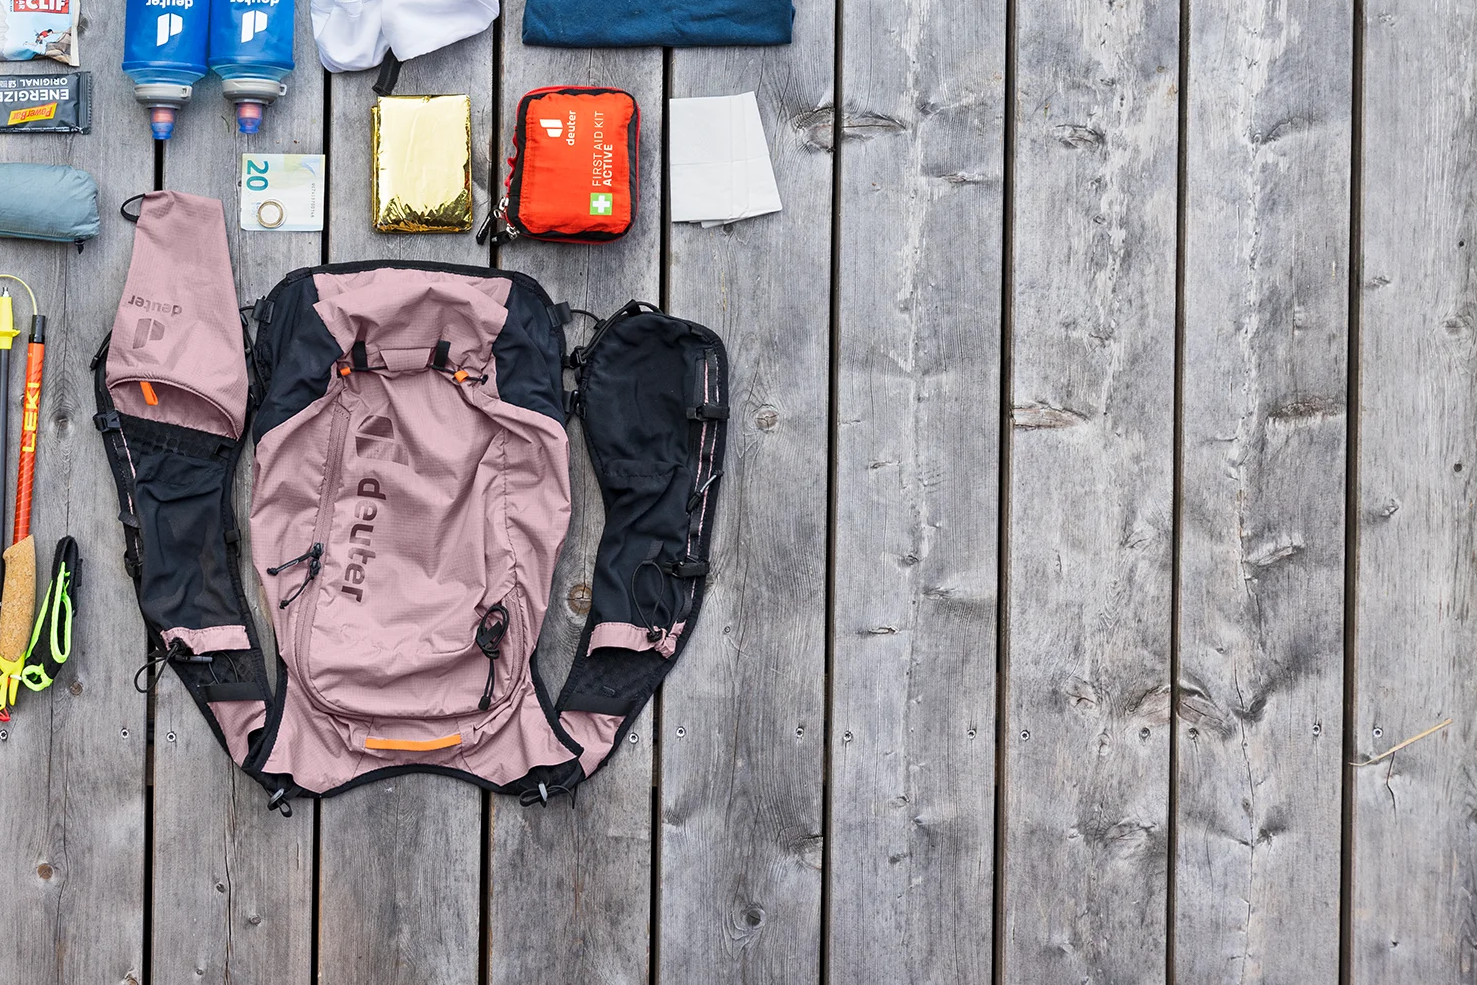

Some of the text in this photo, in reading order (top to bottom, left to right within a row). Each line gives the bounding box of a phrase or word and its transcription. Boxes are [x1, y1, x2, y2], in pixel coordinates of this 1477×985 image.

[20, 77, 68, 86] ORIGINAL
[11, 107, 52, 122] PowerBar
[565, 109, 576, 146] deuter
[592, 110, 604, 187] FIRST AID KIT
[602, 143, 613, 187] ACTIVE
[245, 160, 269, 192] 20
[126, 294, 183, 316] deuter
[22, 382, 40, 452] LEKI
[339, 476, 388, 604] deuter
